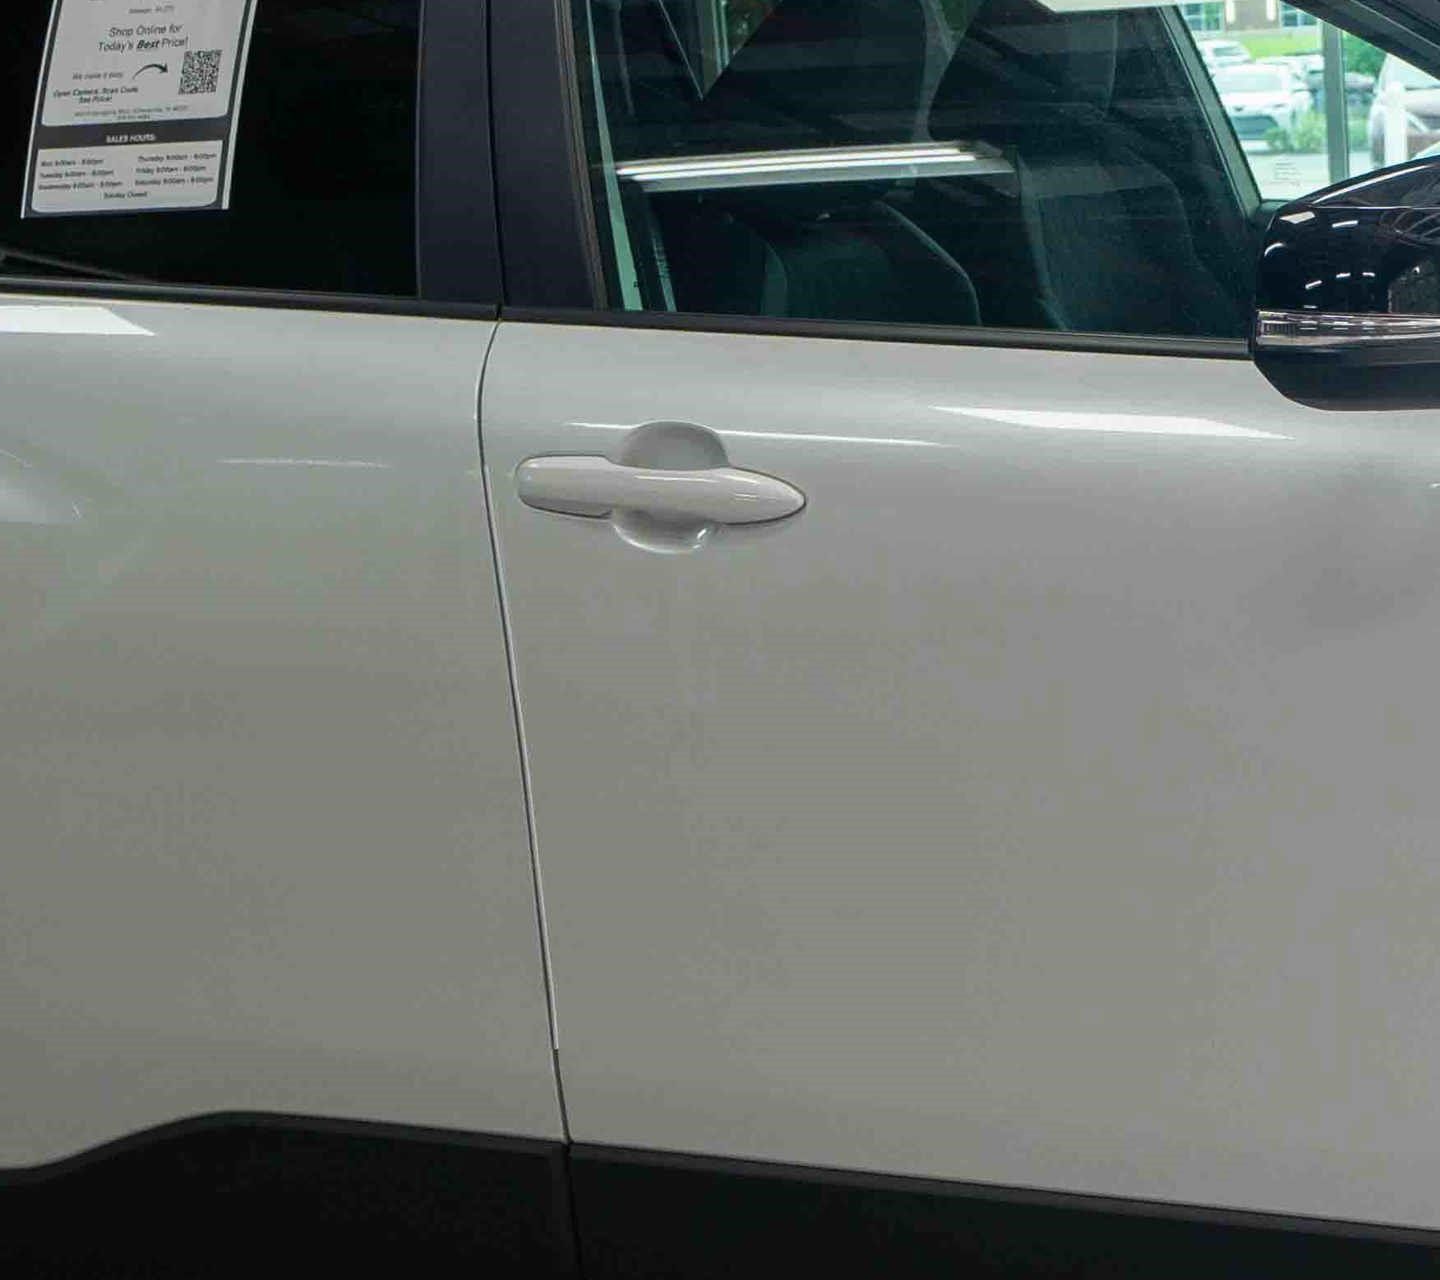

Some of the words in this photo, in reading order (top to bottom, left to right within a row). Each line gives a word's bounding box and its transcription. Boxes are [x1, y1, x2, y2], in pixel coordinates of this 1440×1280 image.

[108, 26, 134, 38] Shop
[136, 24, 167, 36] Online
[169, 23, 183, 33] for
[98, 39, 134, 54] Today's
[137, 39, 160, 49] Best
